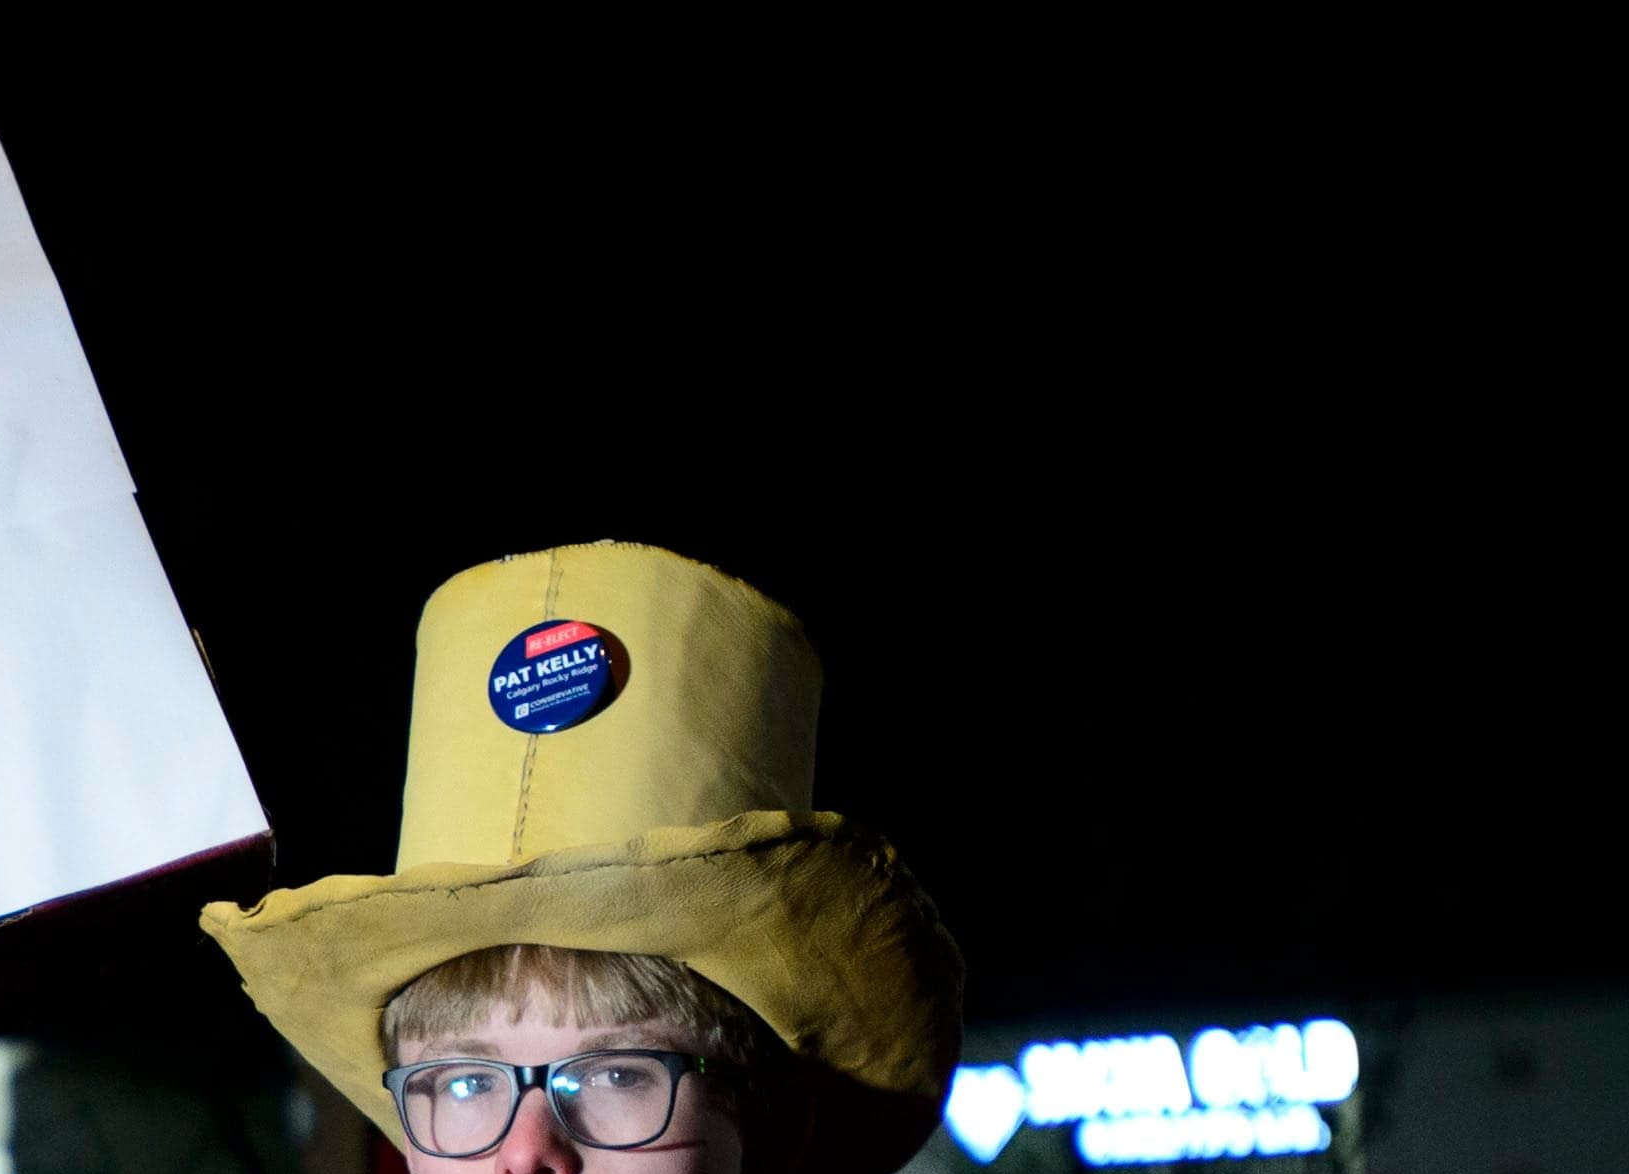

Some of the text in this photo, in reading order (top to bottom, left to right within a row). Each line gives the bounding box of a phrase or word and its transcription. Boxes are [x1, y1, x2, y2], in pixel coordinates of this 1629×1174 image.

[493, 643, 598, 693] PAT KELLY
[506, 663, 599, 700] Calgary Rocky Ridge
